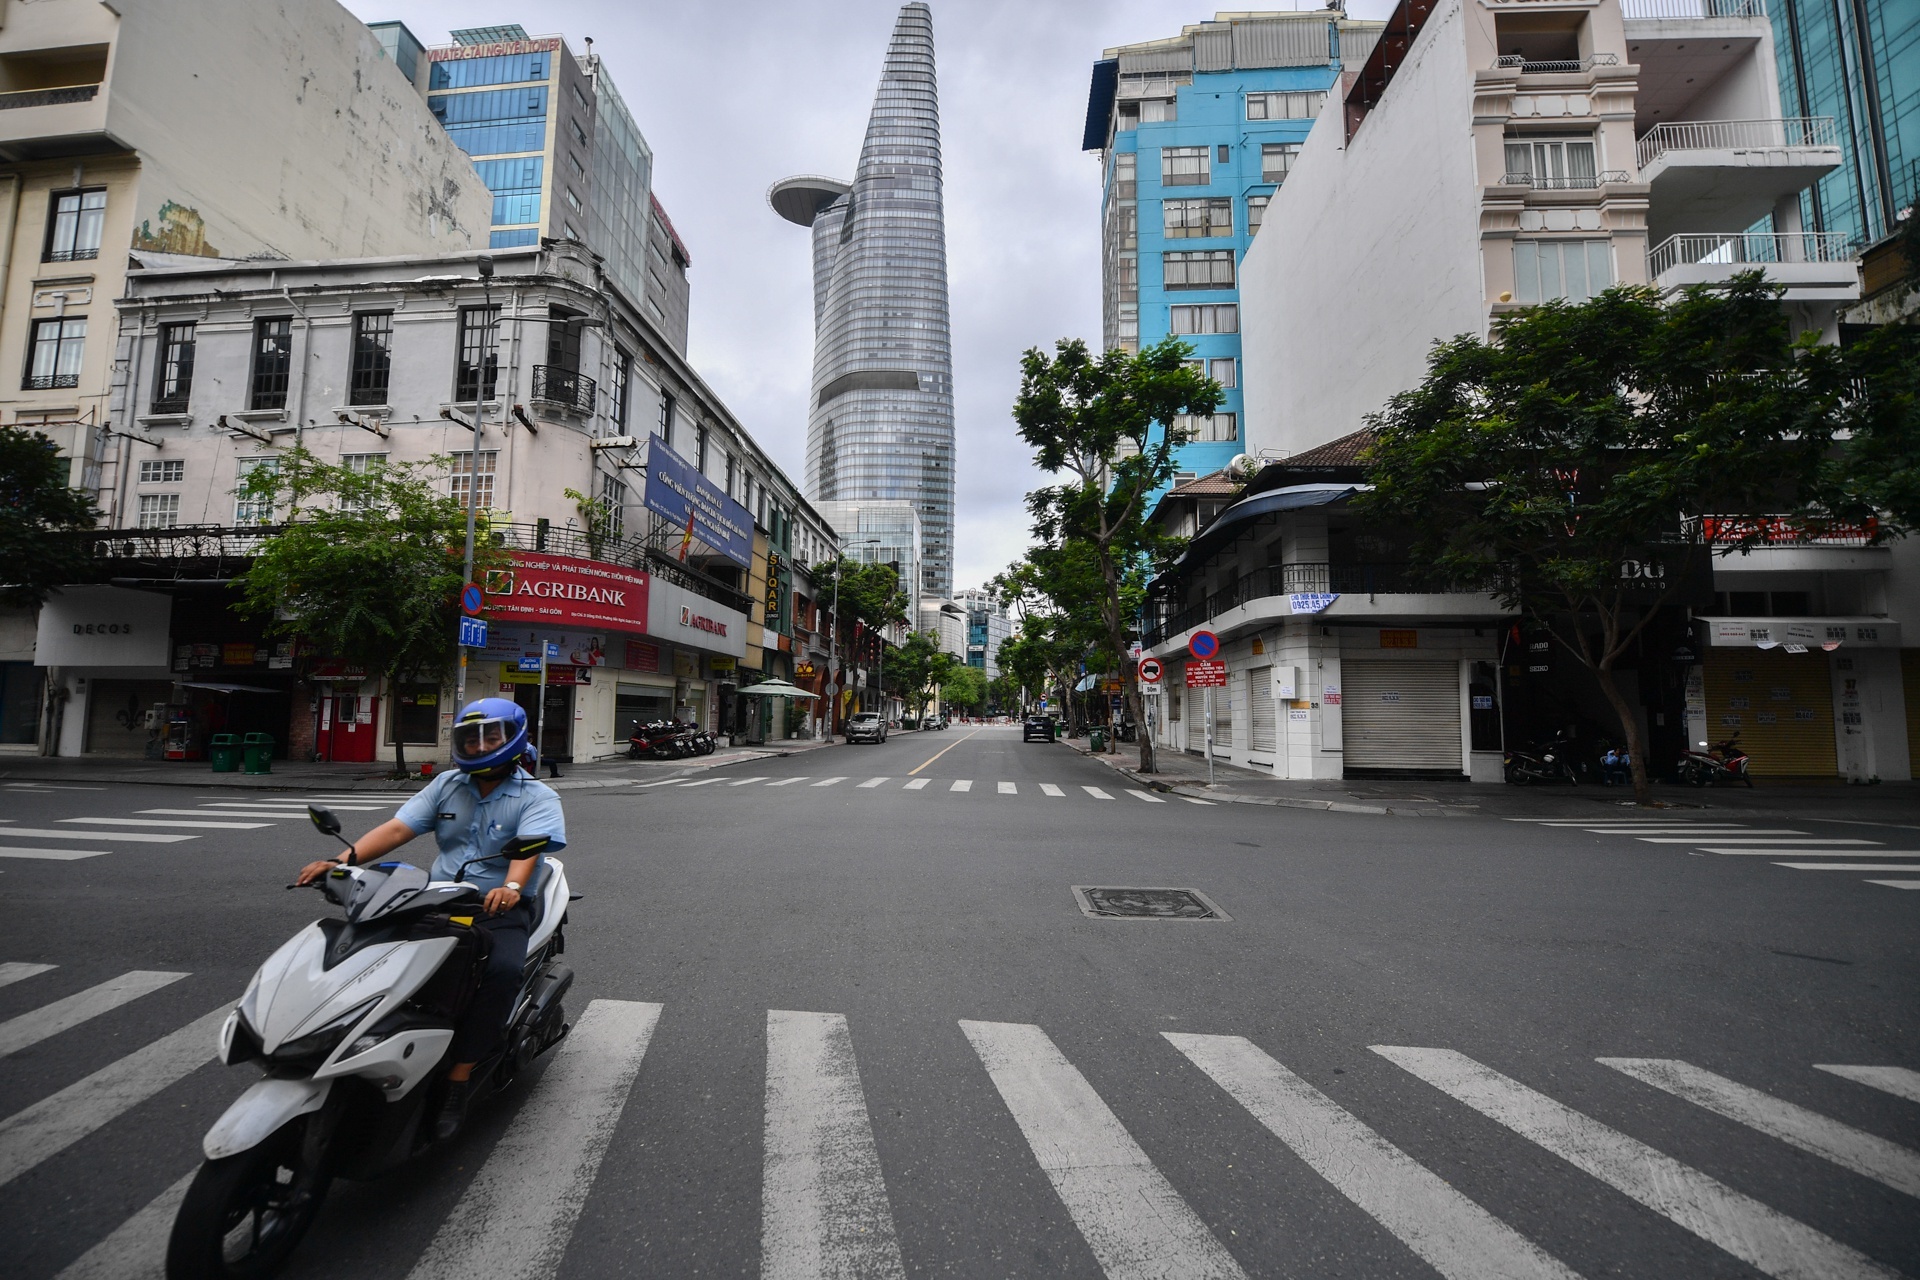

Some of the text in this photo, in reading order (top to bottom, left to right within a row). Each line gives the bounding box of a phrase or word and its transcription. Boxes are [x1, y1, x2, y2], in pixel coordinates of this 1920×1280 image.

[528, 39, 560, 53] TOWER
[658, 471, 674, 488] CÔNG
[674, 482, 686, 496] VIÊN
[525, 561, 550, 572] NGHIỆP
[551, 562, 561, 571] VÀ
[562, 564, 577, 573] PHÁT
[577, 564, 594, 576] TRIỂN
[594, 568, 610, 579] NÔNG
[517, 580, 626, 607] AGRIBANK
[768, 555, 778, 611] SIQAR
[507, 604, 520, 612] TÂN
[520, 605, 534, 614] ĐỊNH
[539, 606, 549, 614] SÀI
[549, 607, 562, 615] GÒN
[73, 623, 131, 634] DECOS
[689, 613, 728, 637] AGRIBANK
